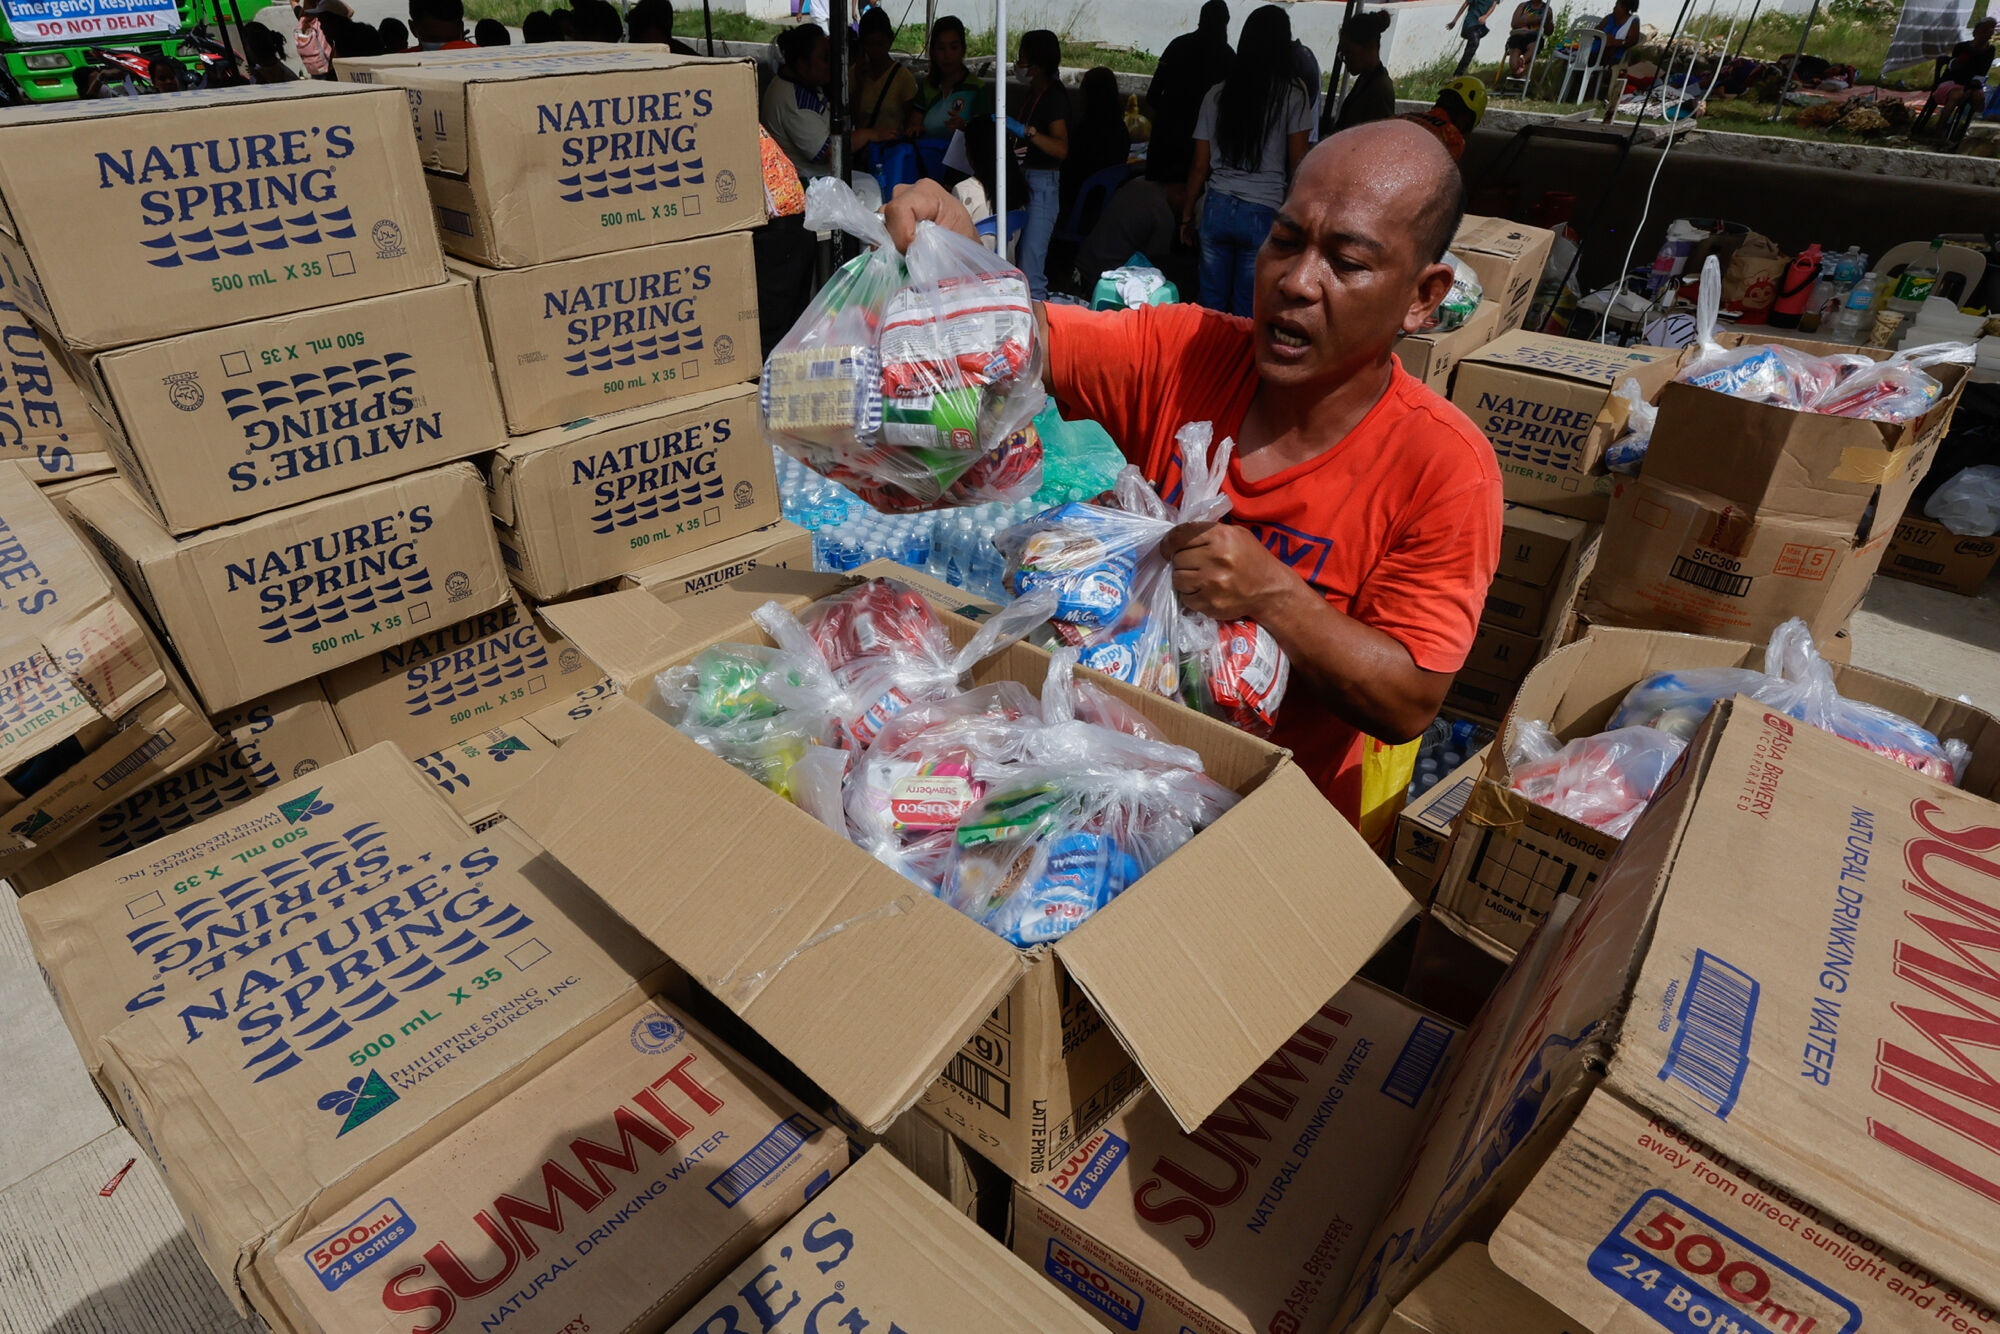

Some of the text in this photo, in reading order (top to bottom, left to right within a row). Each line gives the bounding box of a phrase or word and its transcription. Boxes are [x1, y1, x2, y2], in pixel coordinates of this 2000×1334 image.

[9, 0, 168, 17] Emergency Response
[36, 14, 156, 36] DO NOT DELAY
[537, 89, 713, 134] NATURE'S
[95, 125, 355, 189] NATURE'S
[562, 125, 696, 166] SPRING
[141, 168, 337, 226] SPRING
[601, 203, 678, 227] 500 mL X 35
[211, 261, 322, 293] 500 mL X 35
[544, 265, 711, 319] NATURE'S
[260, 331, 365, 365] 500 mL X 35
[567, 298, 696, 345] SPRING
[604, 368, 676, 394] 500 mL X 35
[244, 387, 414, 450] SPRING
[1476, 392, 1593, 431] NATURE
[228, 412, 443, 493] NATURE'S
[572, 418, 731, 485] NATURE'S
[594, 451, 716, 507] SPRING
[1504, 464, 1557, 483] LITER X 20
[224, 505, 433, 592] NATURE'S
[630, 518, 700, 549] 500 mL X 35
[1692, 548, 1741, 572] SFC300
[1811, 554, 1824, 567] 5
[259, 541, 418, 614] SPRING
[684, 559, 757, 594] NATURE'S
[312, 615, 402, 655] 500 mL X 35
[380, 602, 521, 675] NATURE
[406, 624, 538, 692] SPRING
[15, 708, 58, 738] LITER
[57, 701, 70, 714] X
[450, 687, 524, 725] 500 mL X 35
[1767, 732, 1793, 761] ASIA
[98, 743, 261, 832] SPRING
[898, 801, 962, 816] Rebisco
[906, 784, 957, 794] Strawberry
[1750, 762, 1785, 821] BREWERY
[153, 817, 281, 877] PHILIPPINE SPRING
[232, 812, 278, 833] WATER
[1556, 828, 1606, 860] Monde
[173, 827, 308, 895] 500 mL X 35
[152, 845, 390, 975] SPRING
[1485, 898, 1523, 923] LAGUNA
[177, 846, 499, 1044] NATURE'S
[238, 883, 494, 1046] SPRING
[1801, 805, 1875, 1087] NATURAL DRINKING WATER
[348, 967, 503, 1067] 500 mL X 35
[390, 988, 538, 1083] PHILIPPINE SPRING
[398, 975, 581, 1090] WATER RESOURCES, INC.
[1033, 1100, 1047, 1136] LATTE
[1246, 1038, 1374, 1234] NATURAL DRINKING WATER
[382, 1052, 725, 1334] SUMMIT
[1073, 1144, 1120, 1200] 24 Bottles
[314, 1214, 394, 1269] 500mL
[481, 1130, 729, 1333] NATURAL DRINKING WATER
[1637, 1132, 1935, 1310] away from direct sunlight and
[1648, 1115, 1704, 1153] Keep
[1705, 1149, 1732, 1169] in
[1736, 1167, 1751, 1181] a
[1898, 1260, 1943, 1290] dry
[1944, 1284, 1998, 1324] and
[330, 1226, 405, 1280] 24 Bottles
[1037, 1207, 1061, 1227] Keep
[1165, 1292, 1185, 1308] and
[1056, 1249, 1134, 1312] 500mL
[1061, 1229, 1080, 1246] from
[1082, 1244, 1107, 1264] direct
[1108, 1262, 1144, 1288] sunlight
[1146, 1287, 1164, 1300] and
[1166, 1299, 1203, 1328] freezing
[1284, 1279, 1311, 1311] ASIA
[1303, 1214, 1345, 1276] BREWERY
[1613, 1253, 1661, 1291] 24
[1055, 1265, 1128, 1321] 24 Bottles
